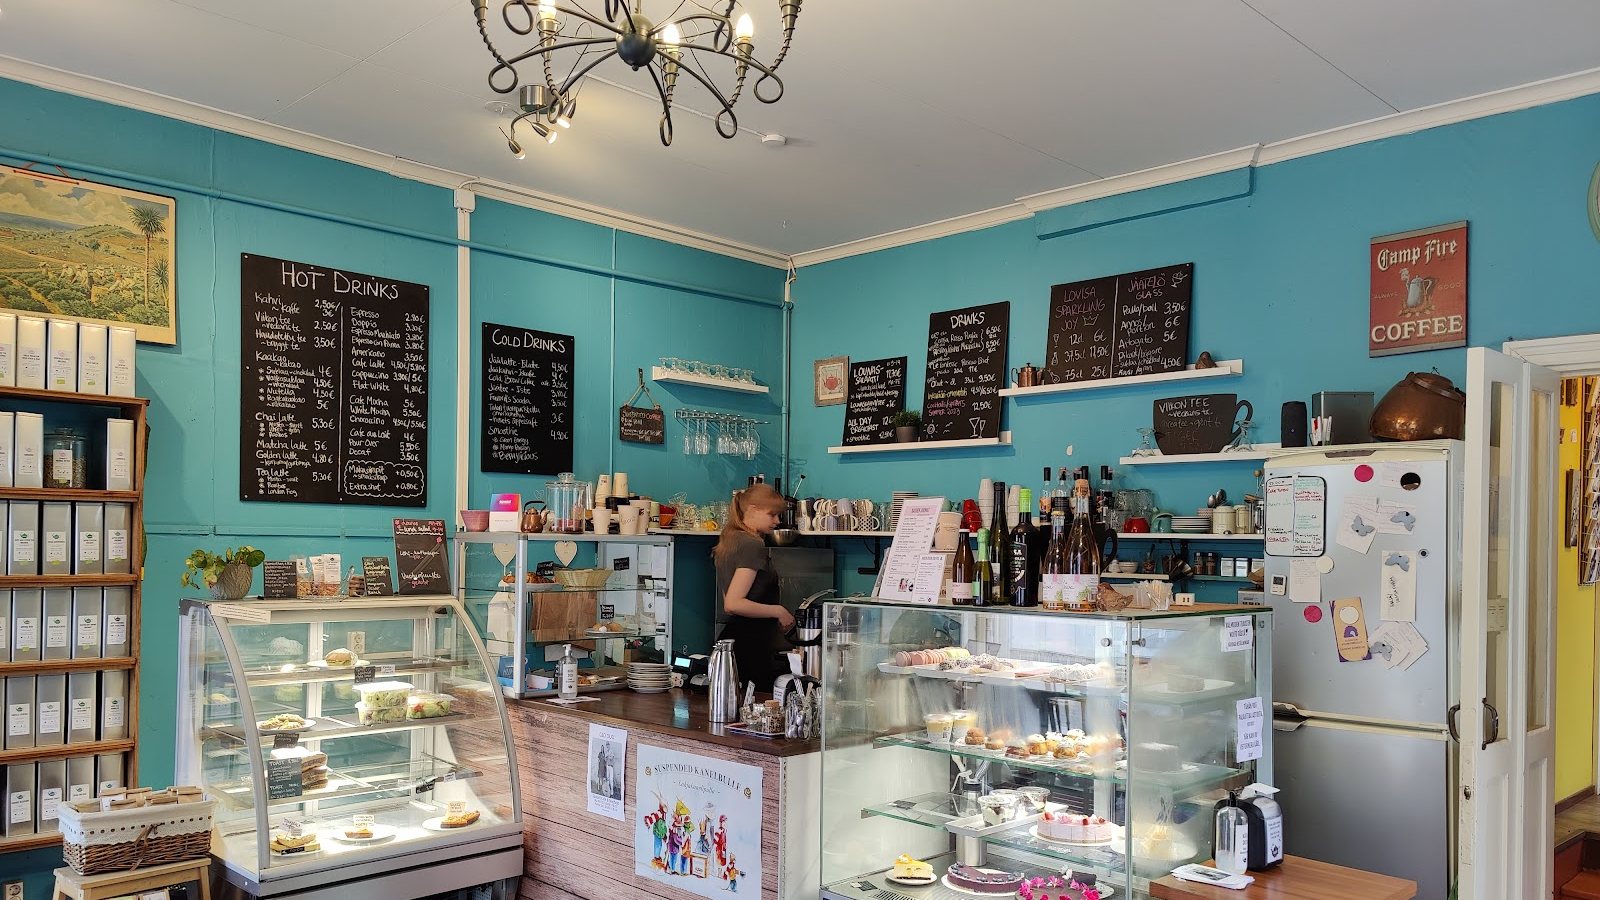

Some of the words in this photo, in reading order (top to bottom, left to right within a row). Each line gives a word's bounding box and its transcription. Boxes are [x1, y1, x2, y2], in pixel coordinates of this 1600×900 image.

[1377, 247, 1421, 271] Camp
[1425, 239, 1458, 264] Fire
[281, 262, 325, 290] HOT
[334, 271, 399, 300] DRINKS
[350, 306, 380, 318] Espresso
[1164, 316, 1180, 328] 6€
[1371, 314, 1464, 343] COFFEE
[492, 329, 520, 347] COLD
[523, 332, 566, 353] DRINKS
[1094, 329, 1107, 343] 6€
[318, 365, 333, 377] 4€
[316, 399, 330, 410] 5€
[255, 411, 277, 421] Chai
[314, 440, 328, 451] 5€
